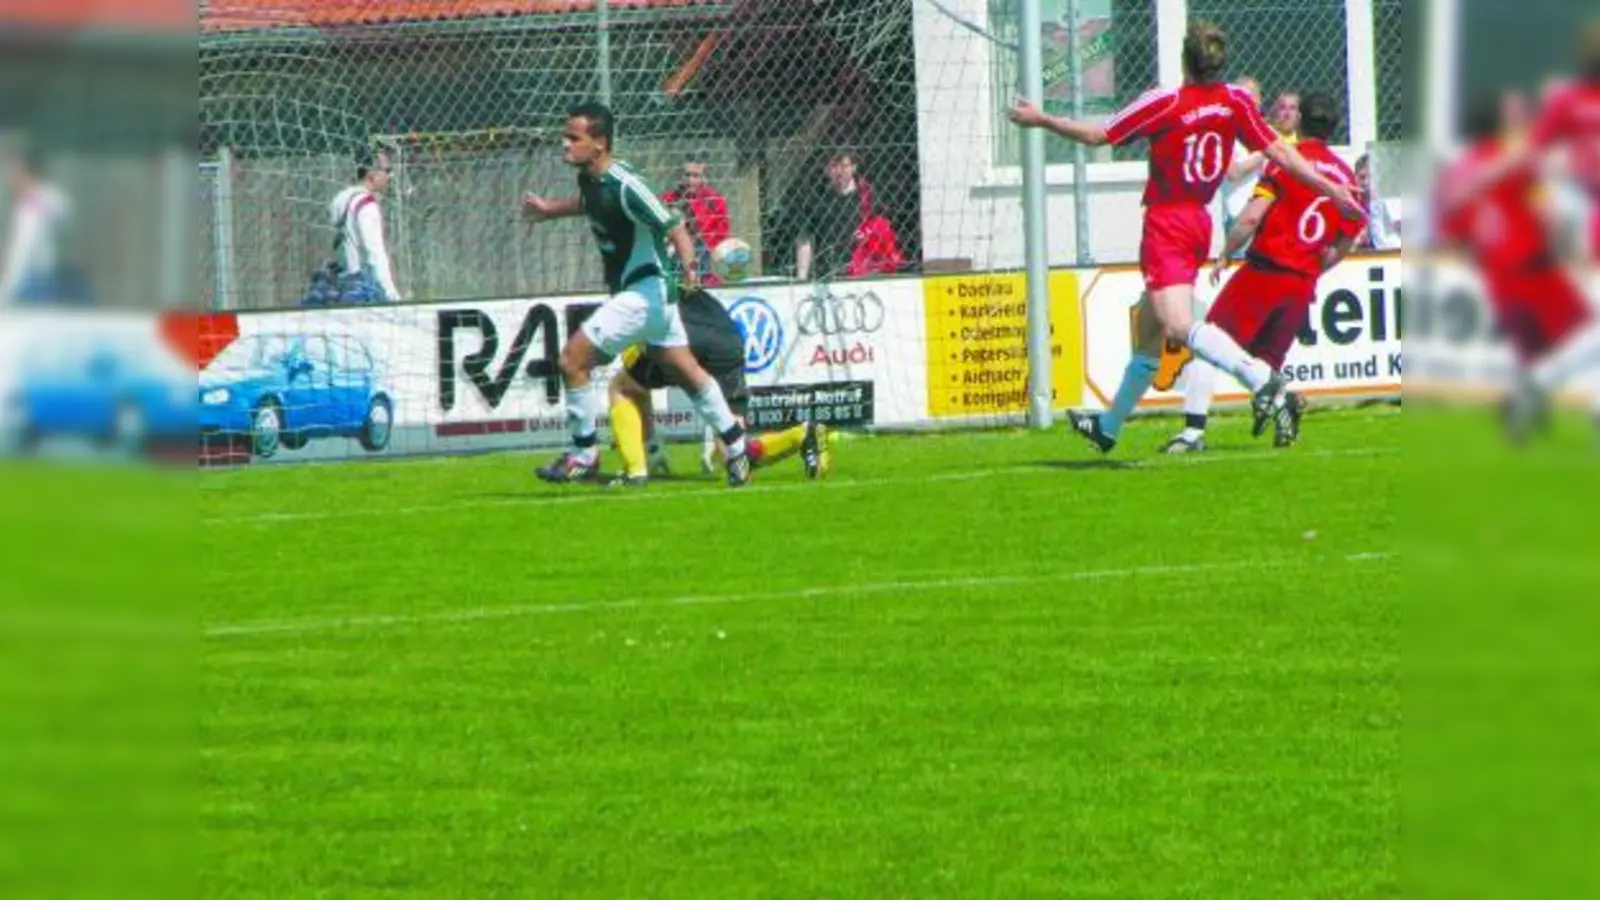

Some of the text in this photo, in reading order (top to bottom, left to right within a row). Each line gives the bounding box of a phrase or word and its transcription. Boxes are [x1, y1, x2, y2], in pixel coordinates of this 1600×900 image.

[1184, 132, 1222, 183] 10
[1299, 195, 1331, 243] 6
[809, 342, 873, 366] Audi
[963, 370, 1021, 384] Aichach
[1334, 354, 1377, 379] und
[815, 387, 862, 403] Notruf
